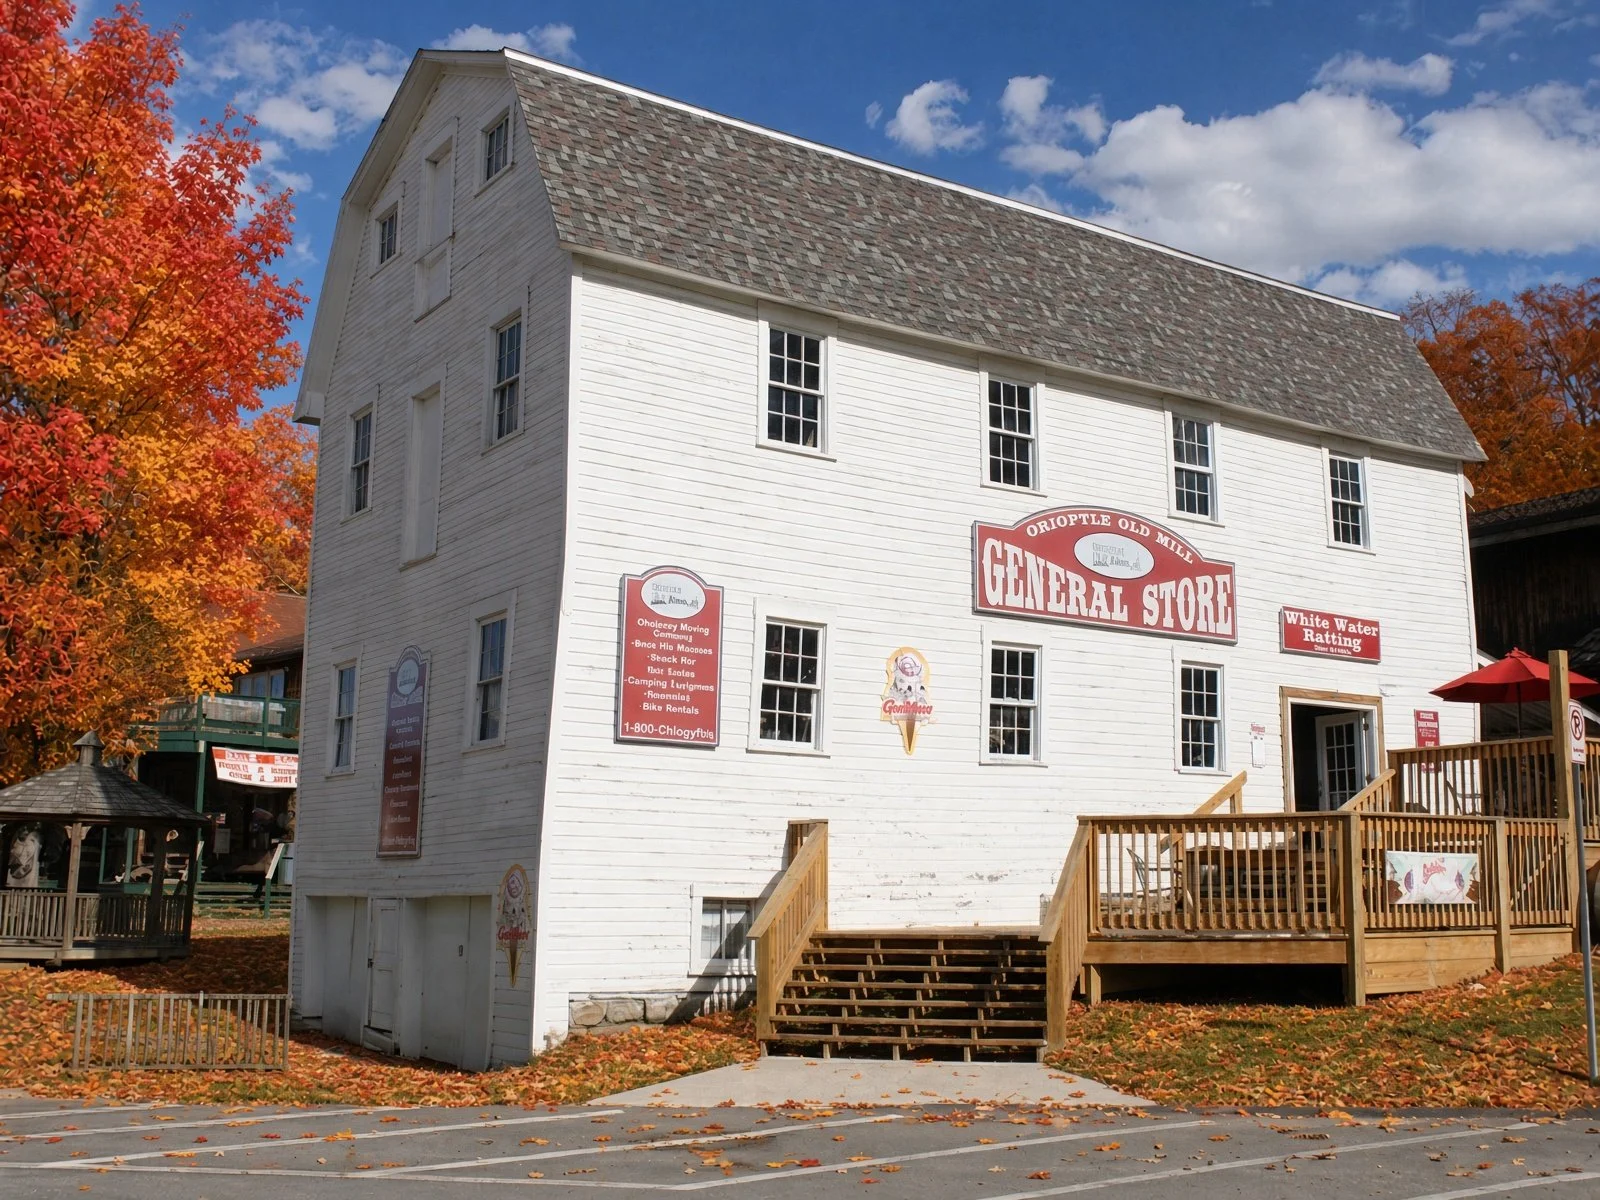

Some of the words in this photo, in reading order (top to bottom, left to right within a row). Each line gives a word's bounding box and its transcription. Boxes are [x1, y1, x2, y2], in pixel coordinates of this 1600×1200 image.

[1118, 518, 1150, 537] OLD
[1155, 532, 1194, 564] MILL
[982, 537, 1128, 622] GENERAL
[1142, 574, 1233, 635] STORE
[680, 623, 709, 636] Moving
[1284, 611, 1329, 629] White
[1333, 617, 1378, 636] Water
[643, 702, 663, 712] Bike
[666, 704, 699, 715] Rentals
